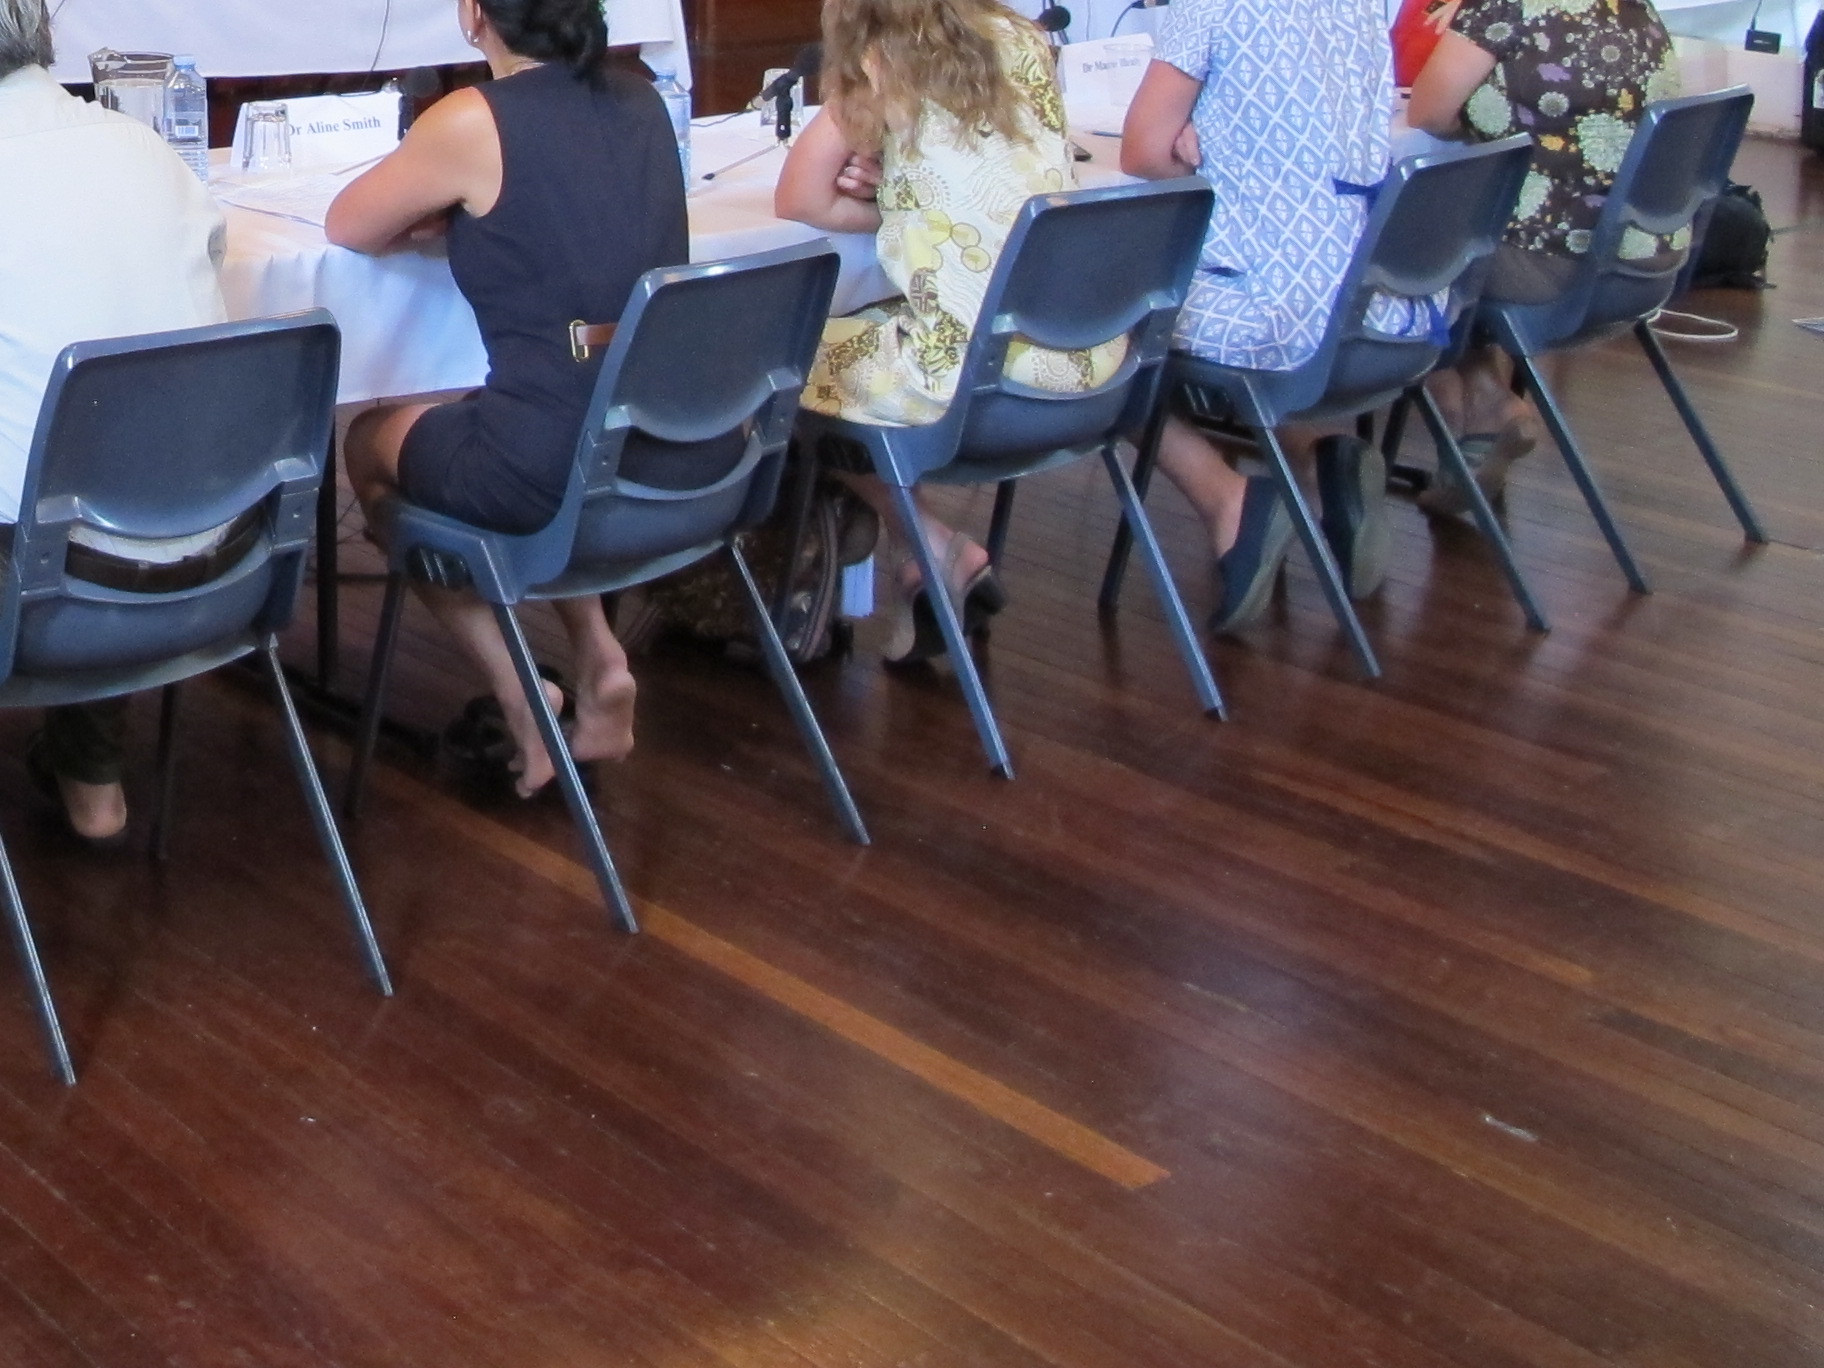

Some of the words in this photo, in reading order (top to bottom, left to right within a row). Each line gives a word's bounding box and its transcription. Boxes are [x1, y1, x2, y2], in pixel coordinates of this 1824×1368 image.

[287, 124, 302, 137] Dr
[306, 121, 340, 135] Aline
[343, 116, 382, 131] Smith
